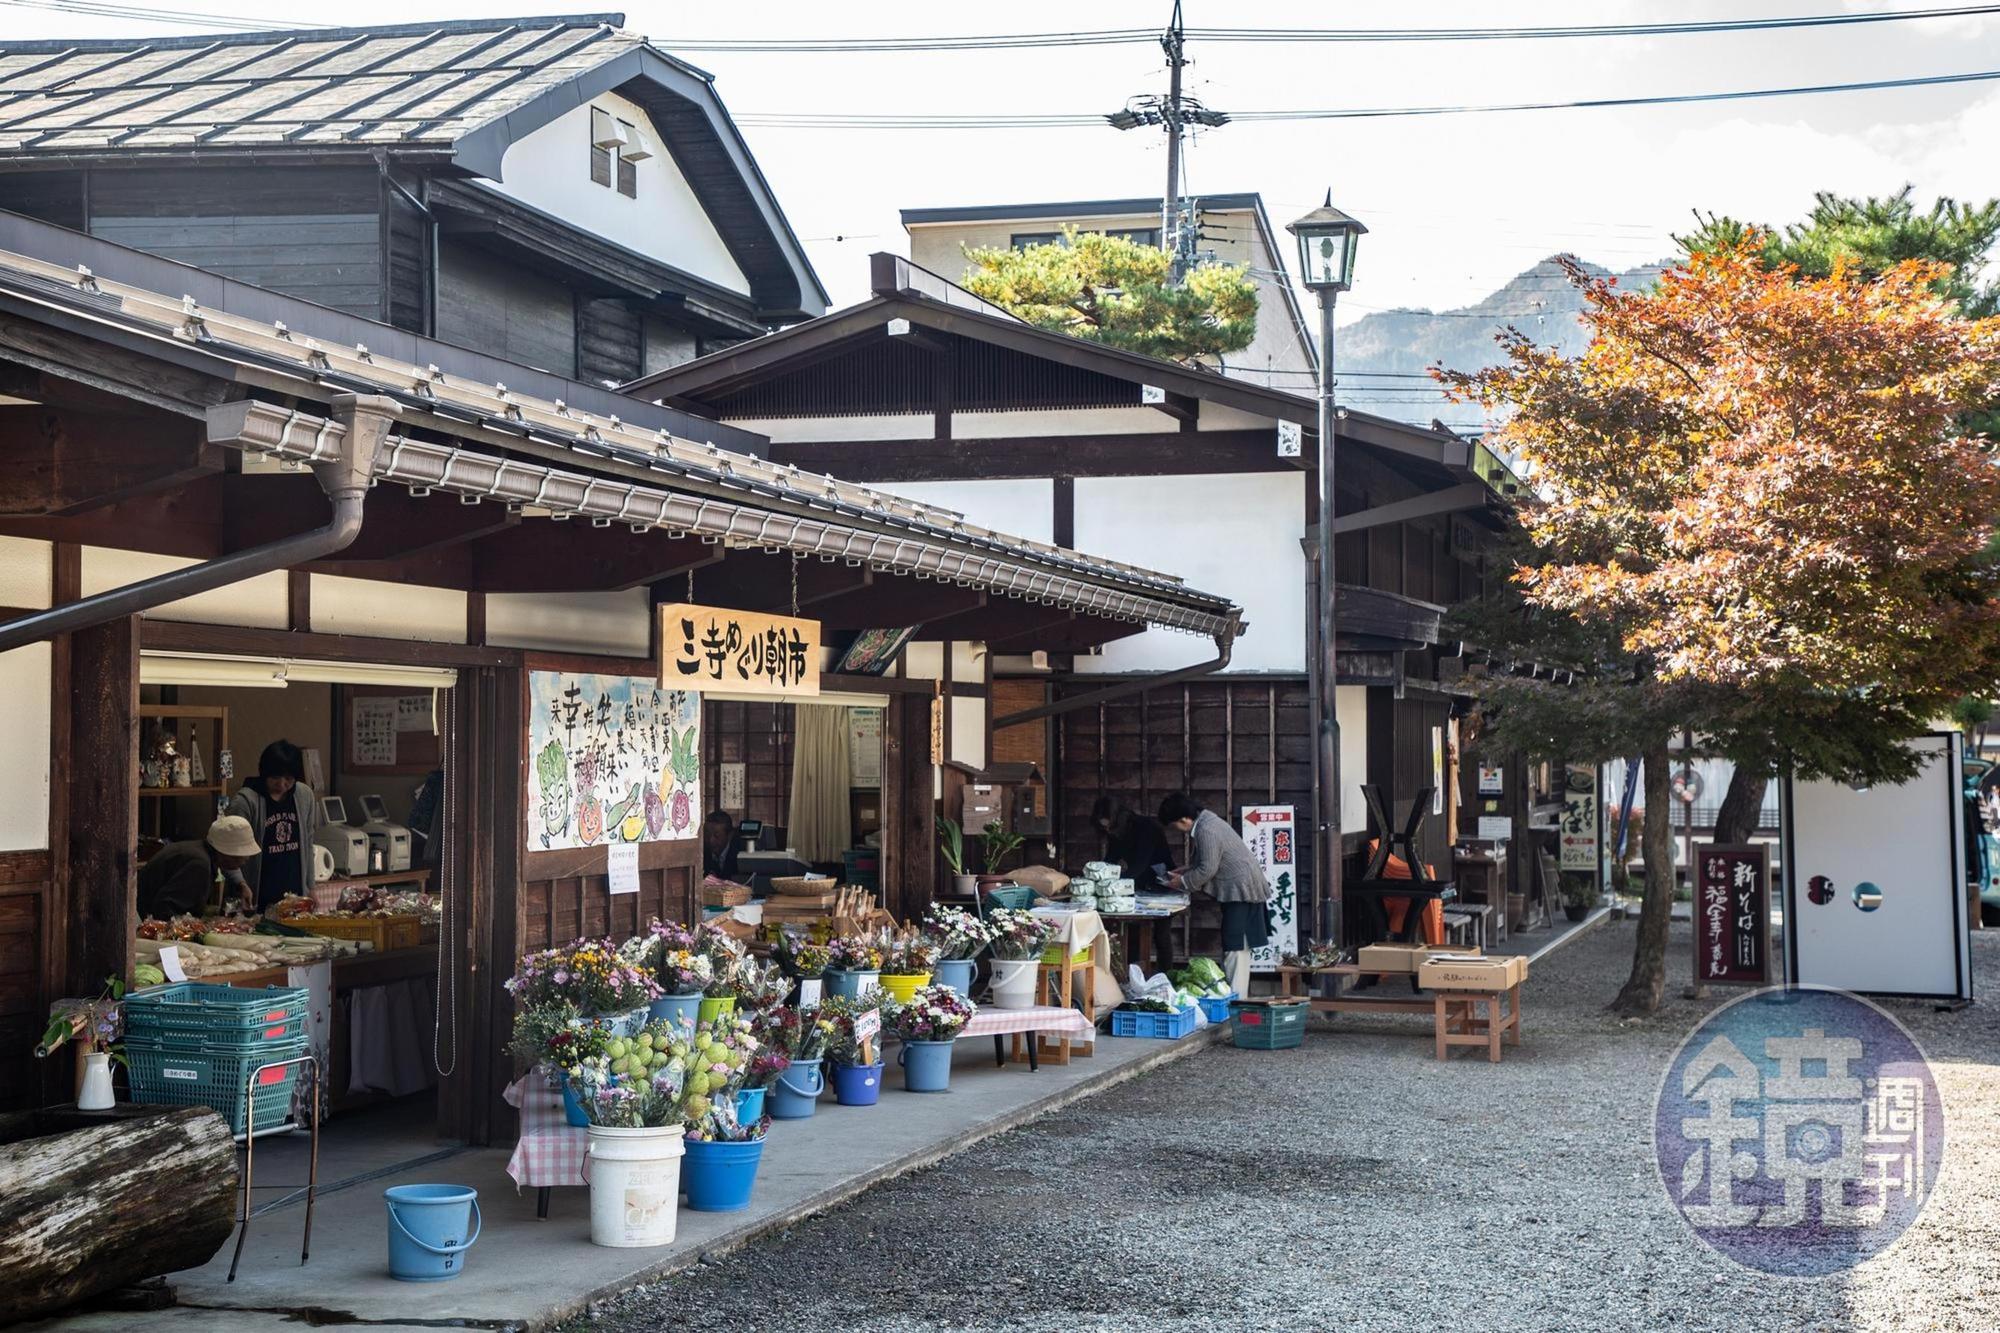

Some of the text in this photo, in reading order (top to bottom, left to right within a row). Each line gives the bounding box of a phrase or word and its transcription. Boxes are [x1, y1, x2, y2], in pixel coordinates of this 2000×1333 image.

[676, 617, 810, 688] 三寺めぐり朝市
[636, 695, 651, 770] いい天気
[661, 712, 672, 755] 西東
[1260, 813, 1284, 821] 営業中
[1275, 830, 1291, 862] 本格
[1276, 871, 1295, 925] 手打ち
[1733, 861, 1757, 930] 新そば
